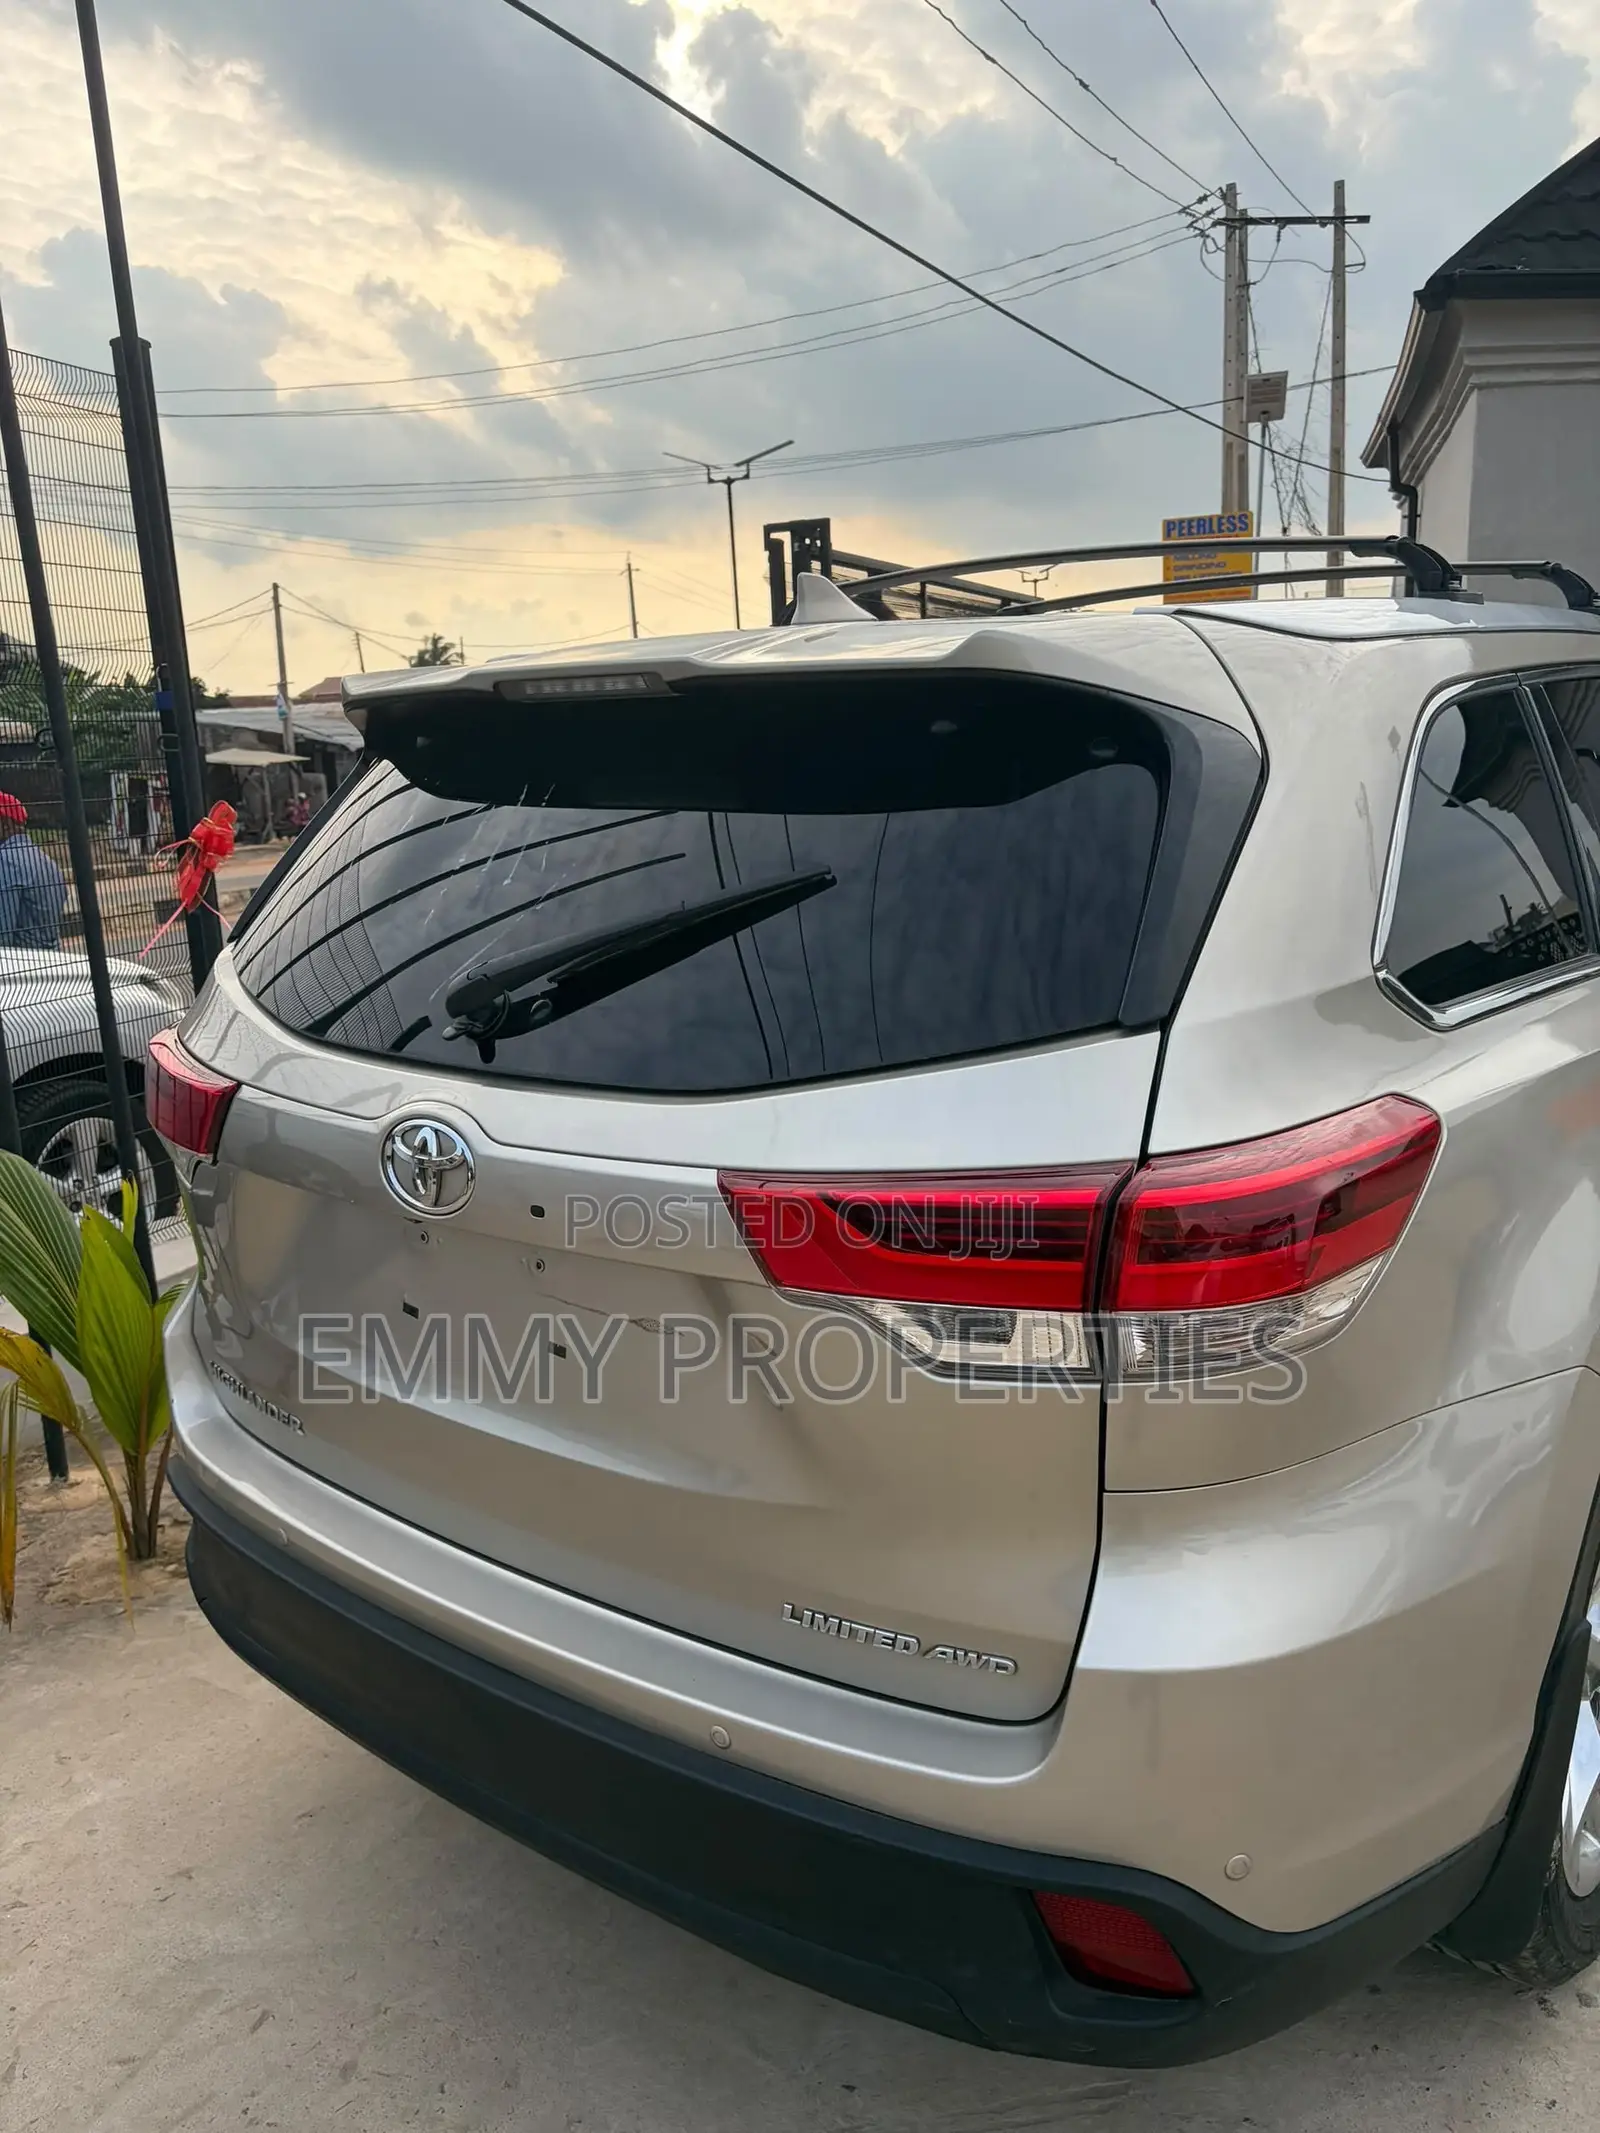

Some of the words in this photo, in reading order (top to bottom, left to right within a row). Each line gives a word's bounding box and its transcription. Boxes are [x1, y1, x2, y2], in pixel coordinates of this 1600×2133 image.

[1166, 513, 1249, 538] PEERLESS
[782, 1602, 922, 1656] LIMITED
[922, 1643, 1019, 1676] AWD
